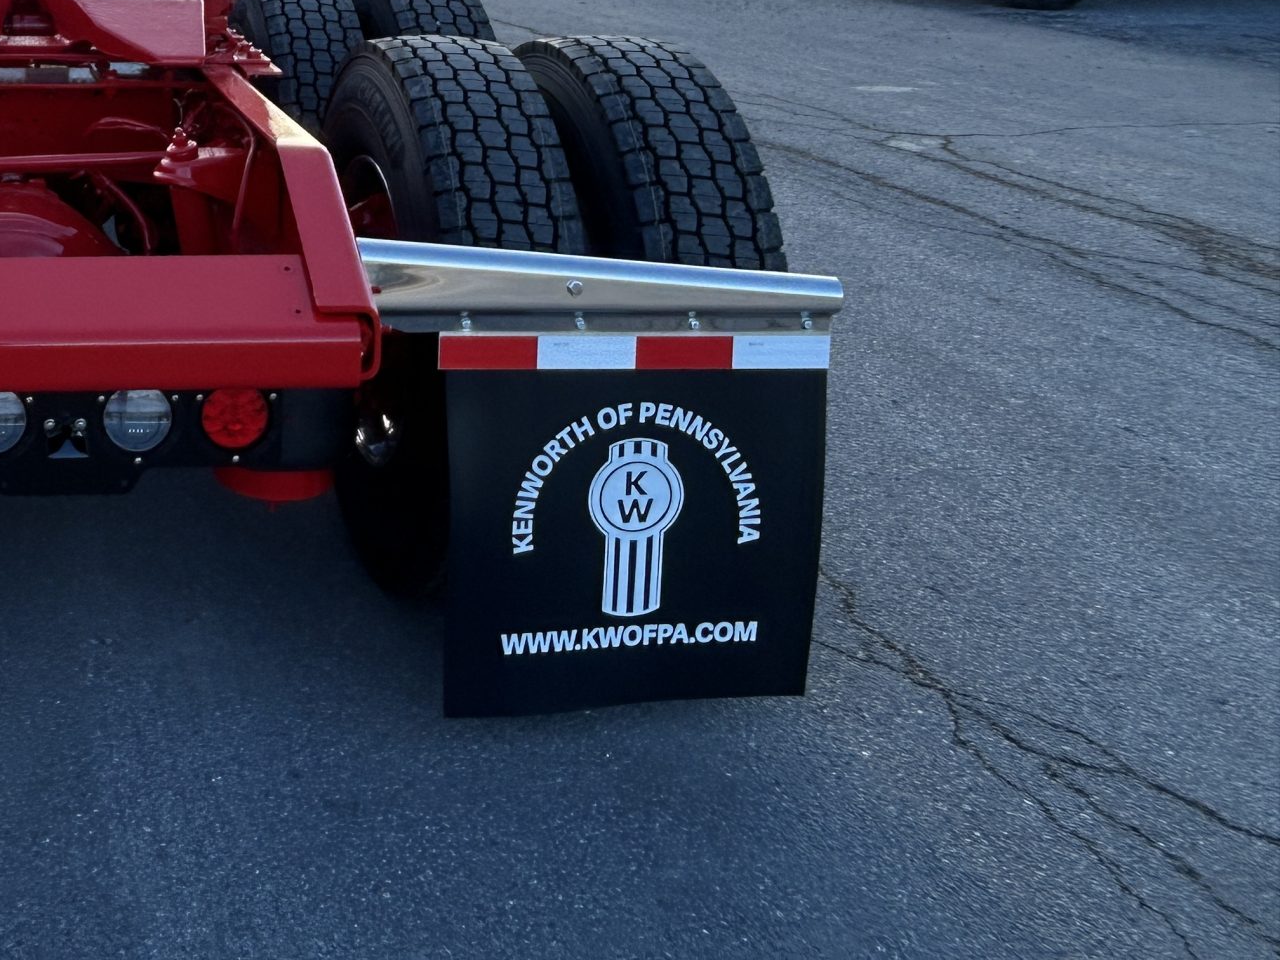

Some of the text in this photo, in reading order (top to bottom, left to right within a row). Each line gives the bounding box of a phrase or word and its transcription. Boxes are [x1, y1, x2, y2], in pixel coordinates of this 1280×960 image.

[512, 402, 761, 554] KENWORTH OF PENNSYLVANIA
[626, 471, 647, 495] K
[618, 499, 653, 523] W
[501, 621, 758, 655] WWW.KWOFPA.COM
